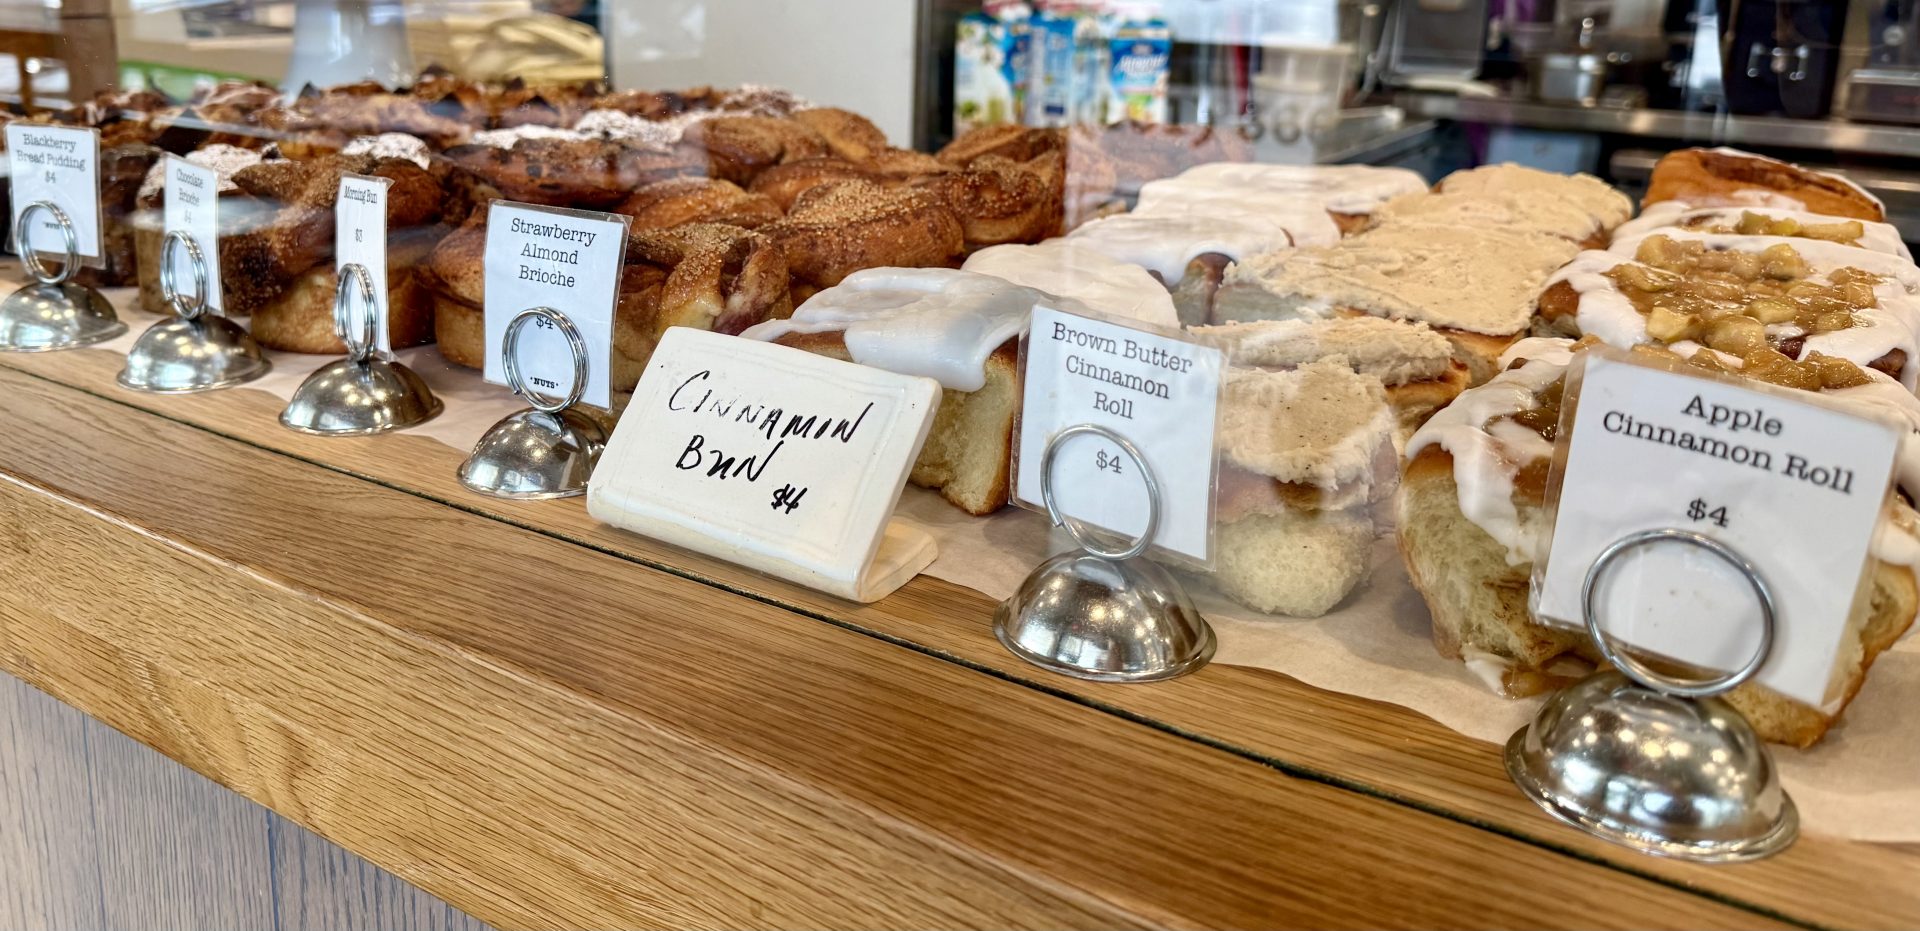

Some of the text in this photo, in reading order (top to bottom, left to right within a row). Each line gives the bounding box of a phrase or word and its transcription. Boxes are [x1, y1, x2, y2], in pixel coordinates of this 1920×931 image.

[23, 133, 76, 153] Blackberry
[17, 150, 86, 172] Bread Pudding
[45, 170, 56, 183] $4
[344, 185, 378, 205] Morning Bun
[355, 228, 363, 242] $3
[511, 217, 597, 248] Strawberry
[520, 243, 579, 265] Almond
[518, 265, 575, 288] Brioche
[535, 314, 554, 330] $4
[1051, 321, 1193, 374] Brown Butter
[1065, 354, 1171, 400] Cinnamon
[1092, 391, 1134, 420] Roll
[1680, 394, 1784, 437] Apple
[675, 434, 784, 482] BUN
[1095, 448, 1123, 474] $4
[1602, 410, 1856, 495] Cinnamon Roll
[770, 483, 808, 515] $4
[1686, 497, 1730, 528] $4
